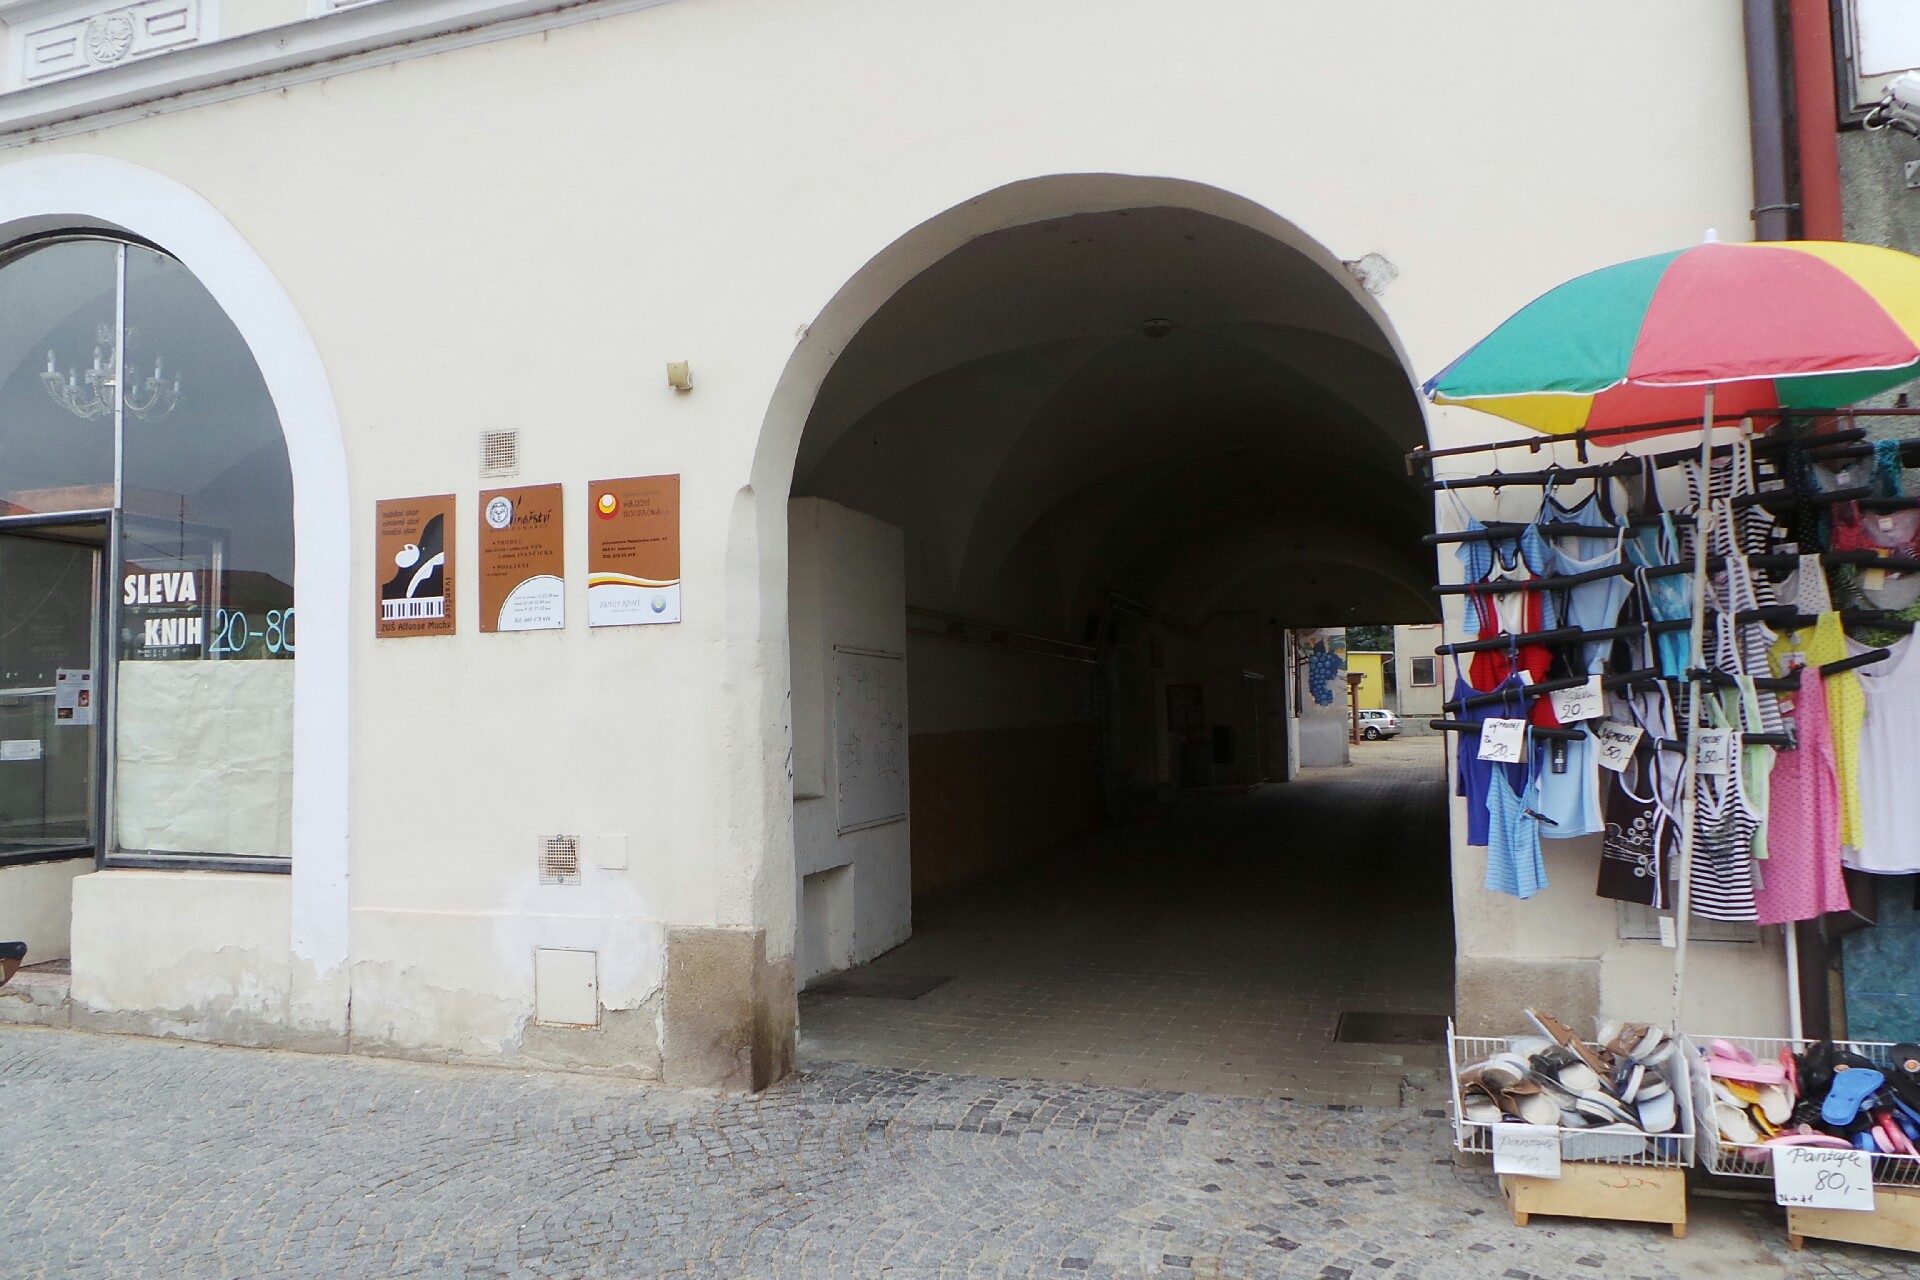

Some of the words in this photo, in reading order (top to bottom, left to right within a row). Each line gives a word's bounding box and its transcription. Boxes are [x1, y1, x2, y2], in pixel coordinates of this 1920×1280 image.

[124, 572, 196, 604] SLEVA
[144, 617, 202, 646] KNIH
[381, 622, 396, 632] ZUŠ
[397, 622, 426, 631] Alfonse
[427, 620, 451, 630] Muchy
